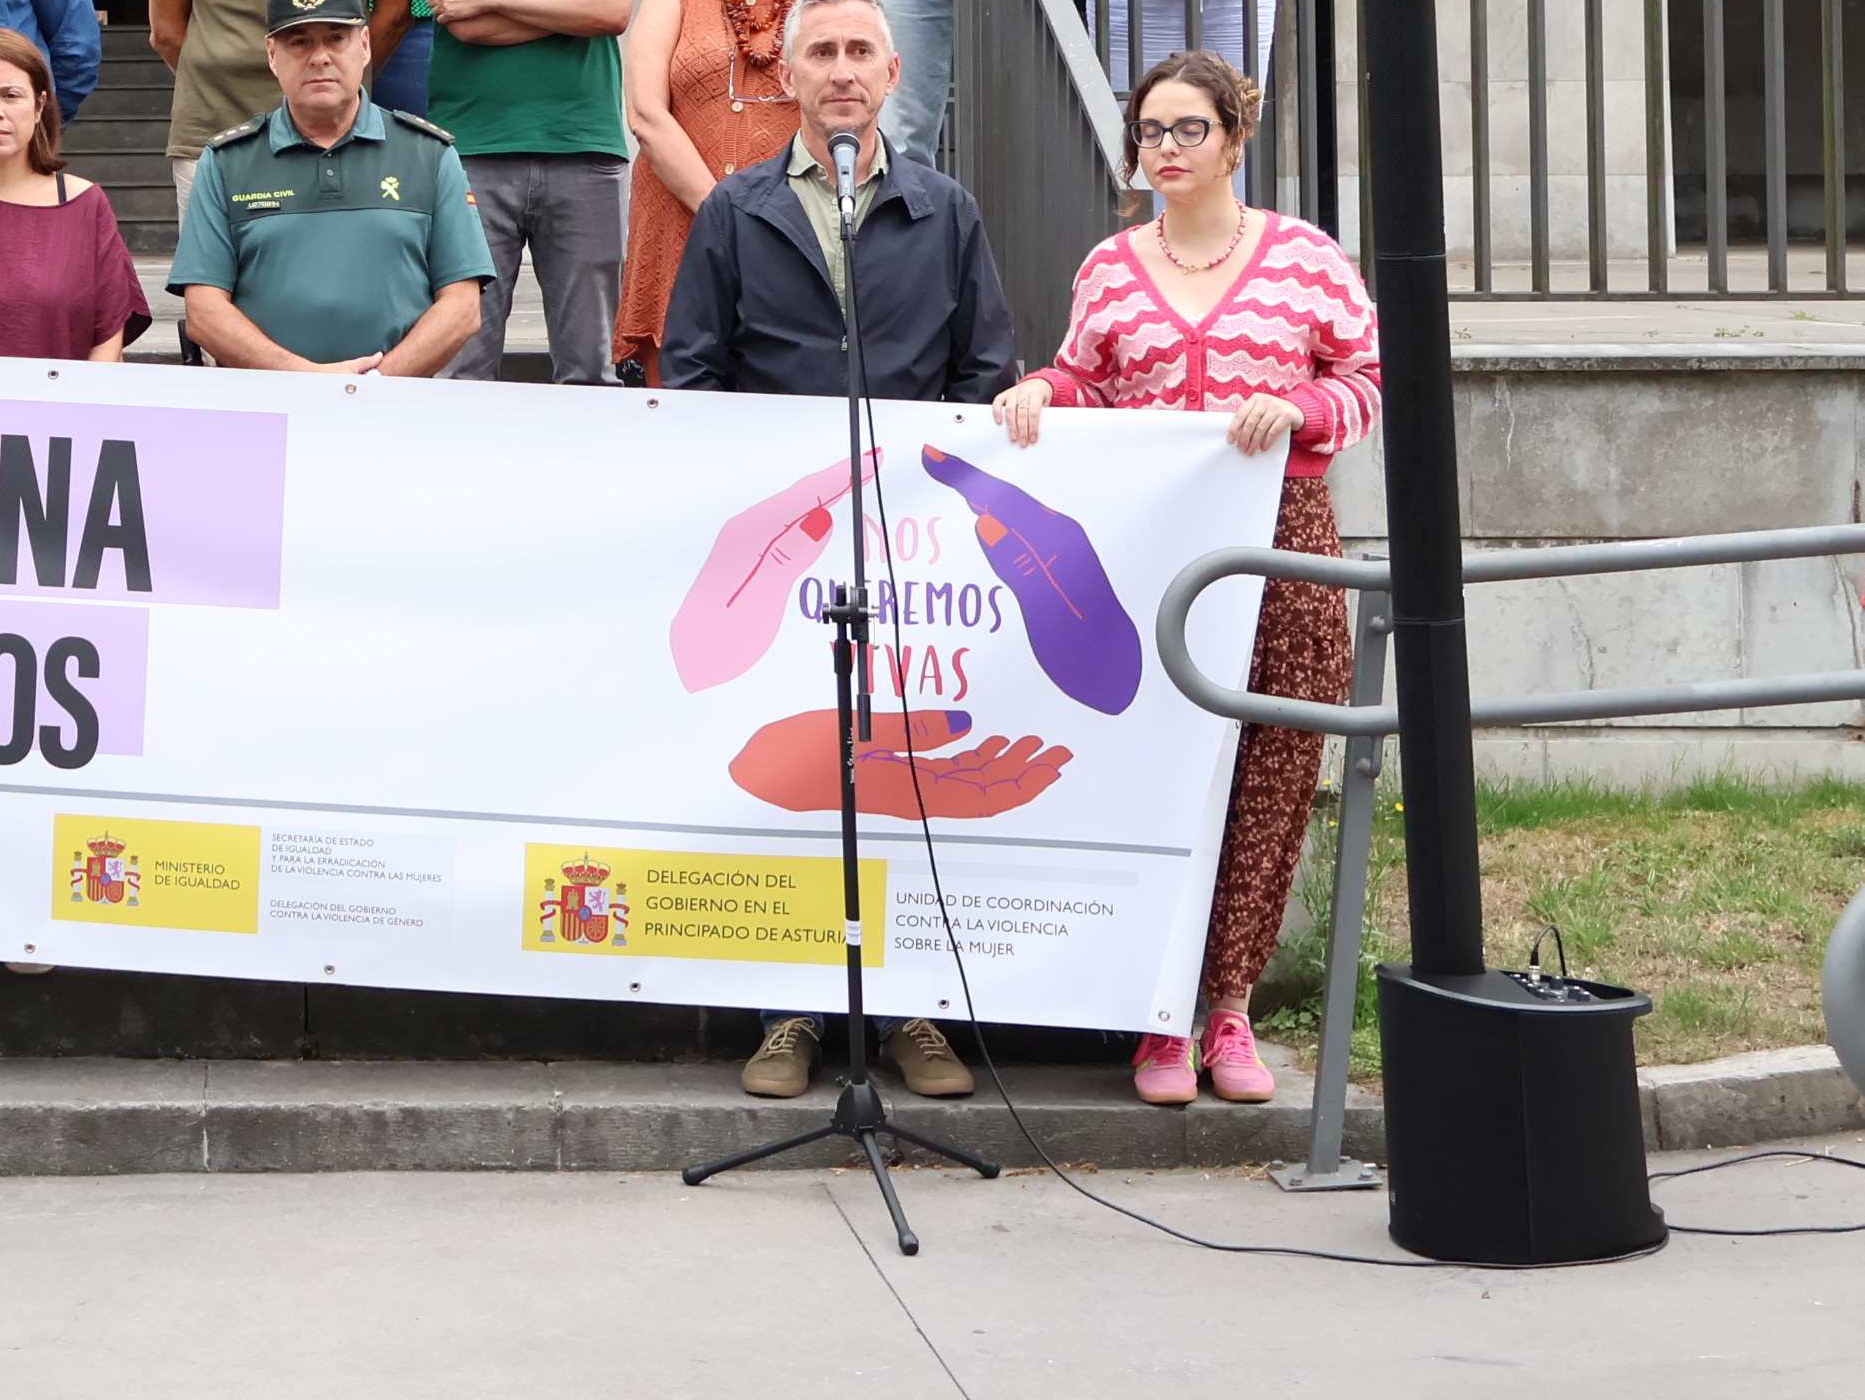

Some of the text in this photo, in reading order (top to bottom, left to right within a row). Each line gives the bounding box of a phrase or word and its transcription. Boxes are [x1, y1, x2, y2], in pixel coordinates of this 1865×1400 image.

[231, 189, 295, 201] GUARDIA CIVIL
[271, 844, 332, 855] DE IGUALDAD
[325, 836, 337, 845] DE
[339, 837, 374, 847] ESTADO
[155, 860, 225, 875] MINISTERIO
[279, 855, 302, 863] PARA
[303, 856, 315, 865] LA
[154, 875, 240, 890] DE IGUALDAD
[271, 865, 442, 884] DE LA VIOLENCIA CONTRA LAS MUJERES
[646, 869, 797, 889] DELEGACIÓN DEL
[329, 903, 346, 913] DEL
[348, 904, 397, 915] GOBIERNO
[646, 896, 791, 916] GOBIERNO EN EL
[962, 895, 982, 908] DE
[986, 896, 1114, 916] COORDINACIÓN
[269, 910, 309, 920] CONTRA
[311, 913, 322, 921] LA
[322, 913, 371, 925] VIOLENCIA
[373, 916, 385, 926] DE
[644, 922, 750, 940] PRINCIPADO
[755, 927, 778, 942] DE
[781, 928, 849, 945] ASTURI
[966, 918, 985, 931] LA
[986, 919, 1069, 936] VIOLENCIA
[894, 937, 1015, 958] SOBRE LA MUJER
